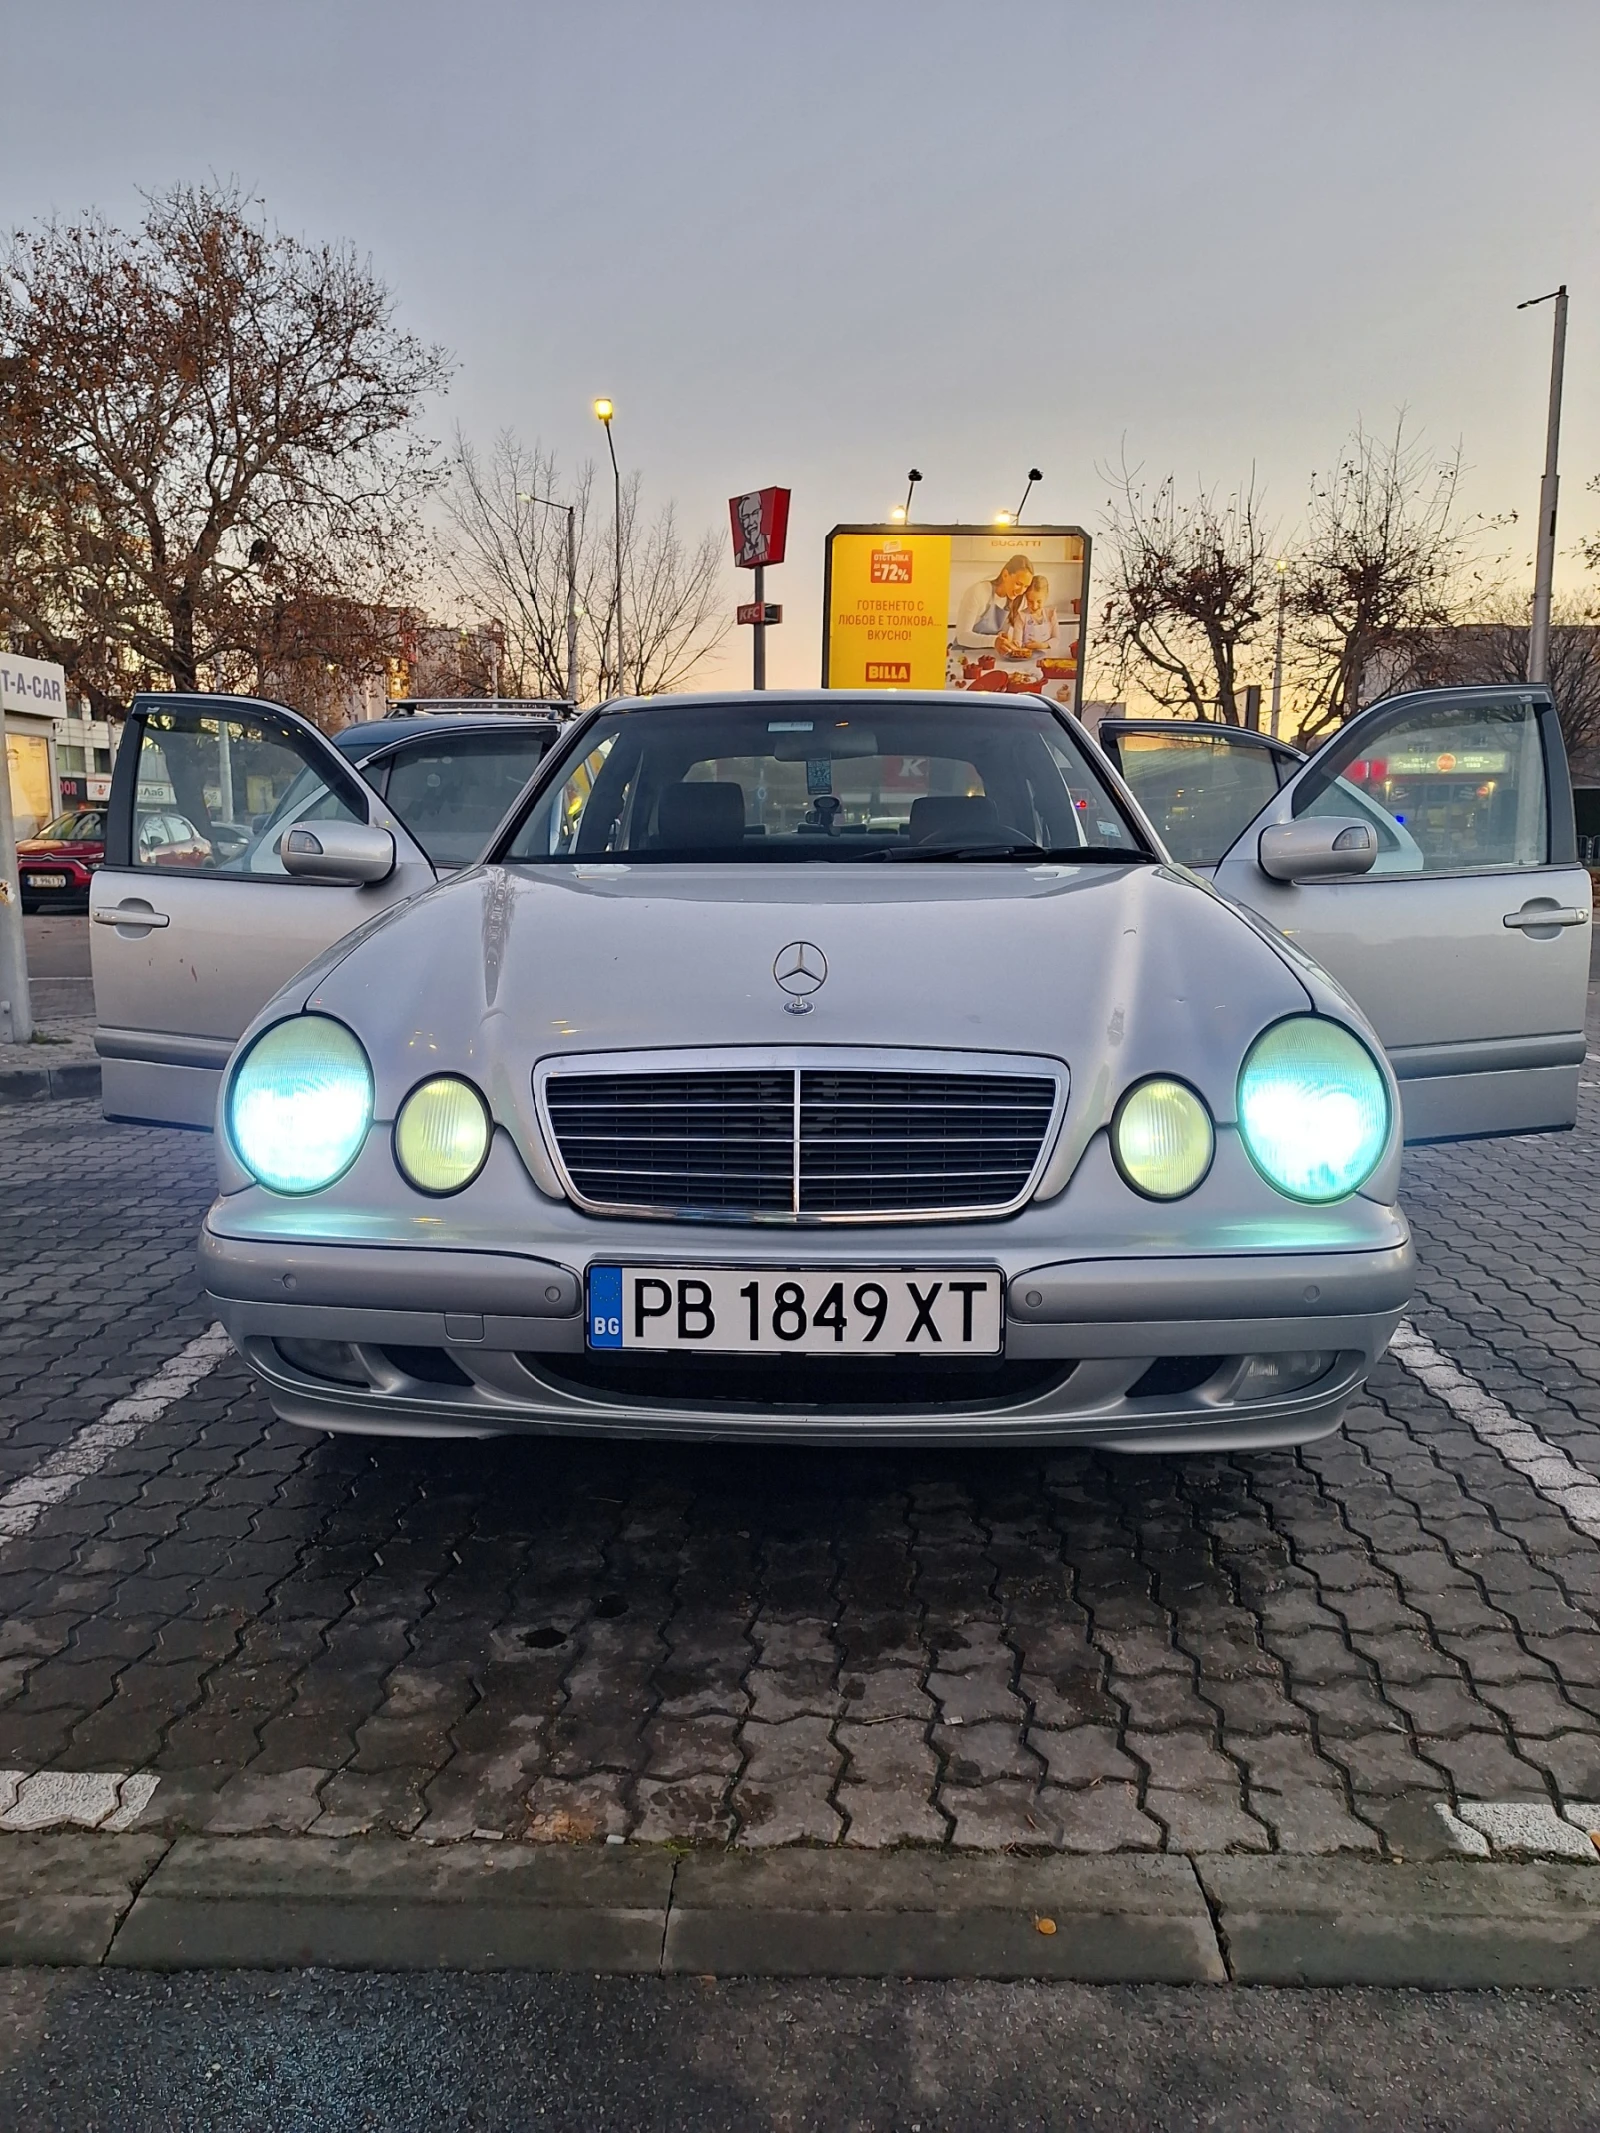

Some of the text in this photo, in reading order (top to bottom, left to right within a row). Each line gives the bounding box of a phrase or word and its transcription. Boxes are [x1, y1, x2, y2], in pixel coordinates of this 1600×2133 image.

[874, 563, 909, 581] -72%
[857, 600, 924, 611] ГОТВЕНЕТО С
[740, 606, 760, 620] KFC
[838, 614, 876, 626] ЛЮБОВ
[878, 615, 884, 626] Е
[867, 629, 912, 641] ВКУСНО!
[868, 665, 908, 680] BILLA
[634, 1278, 987, 1343] PB 1849 XT
[594, 1317, 620, 1336] BG
